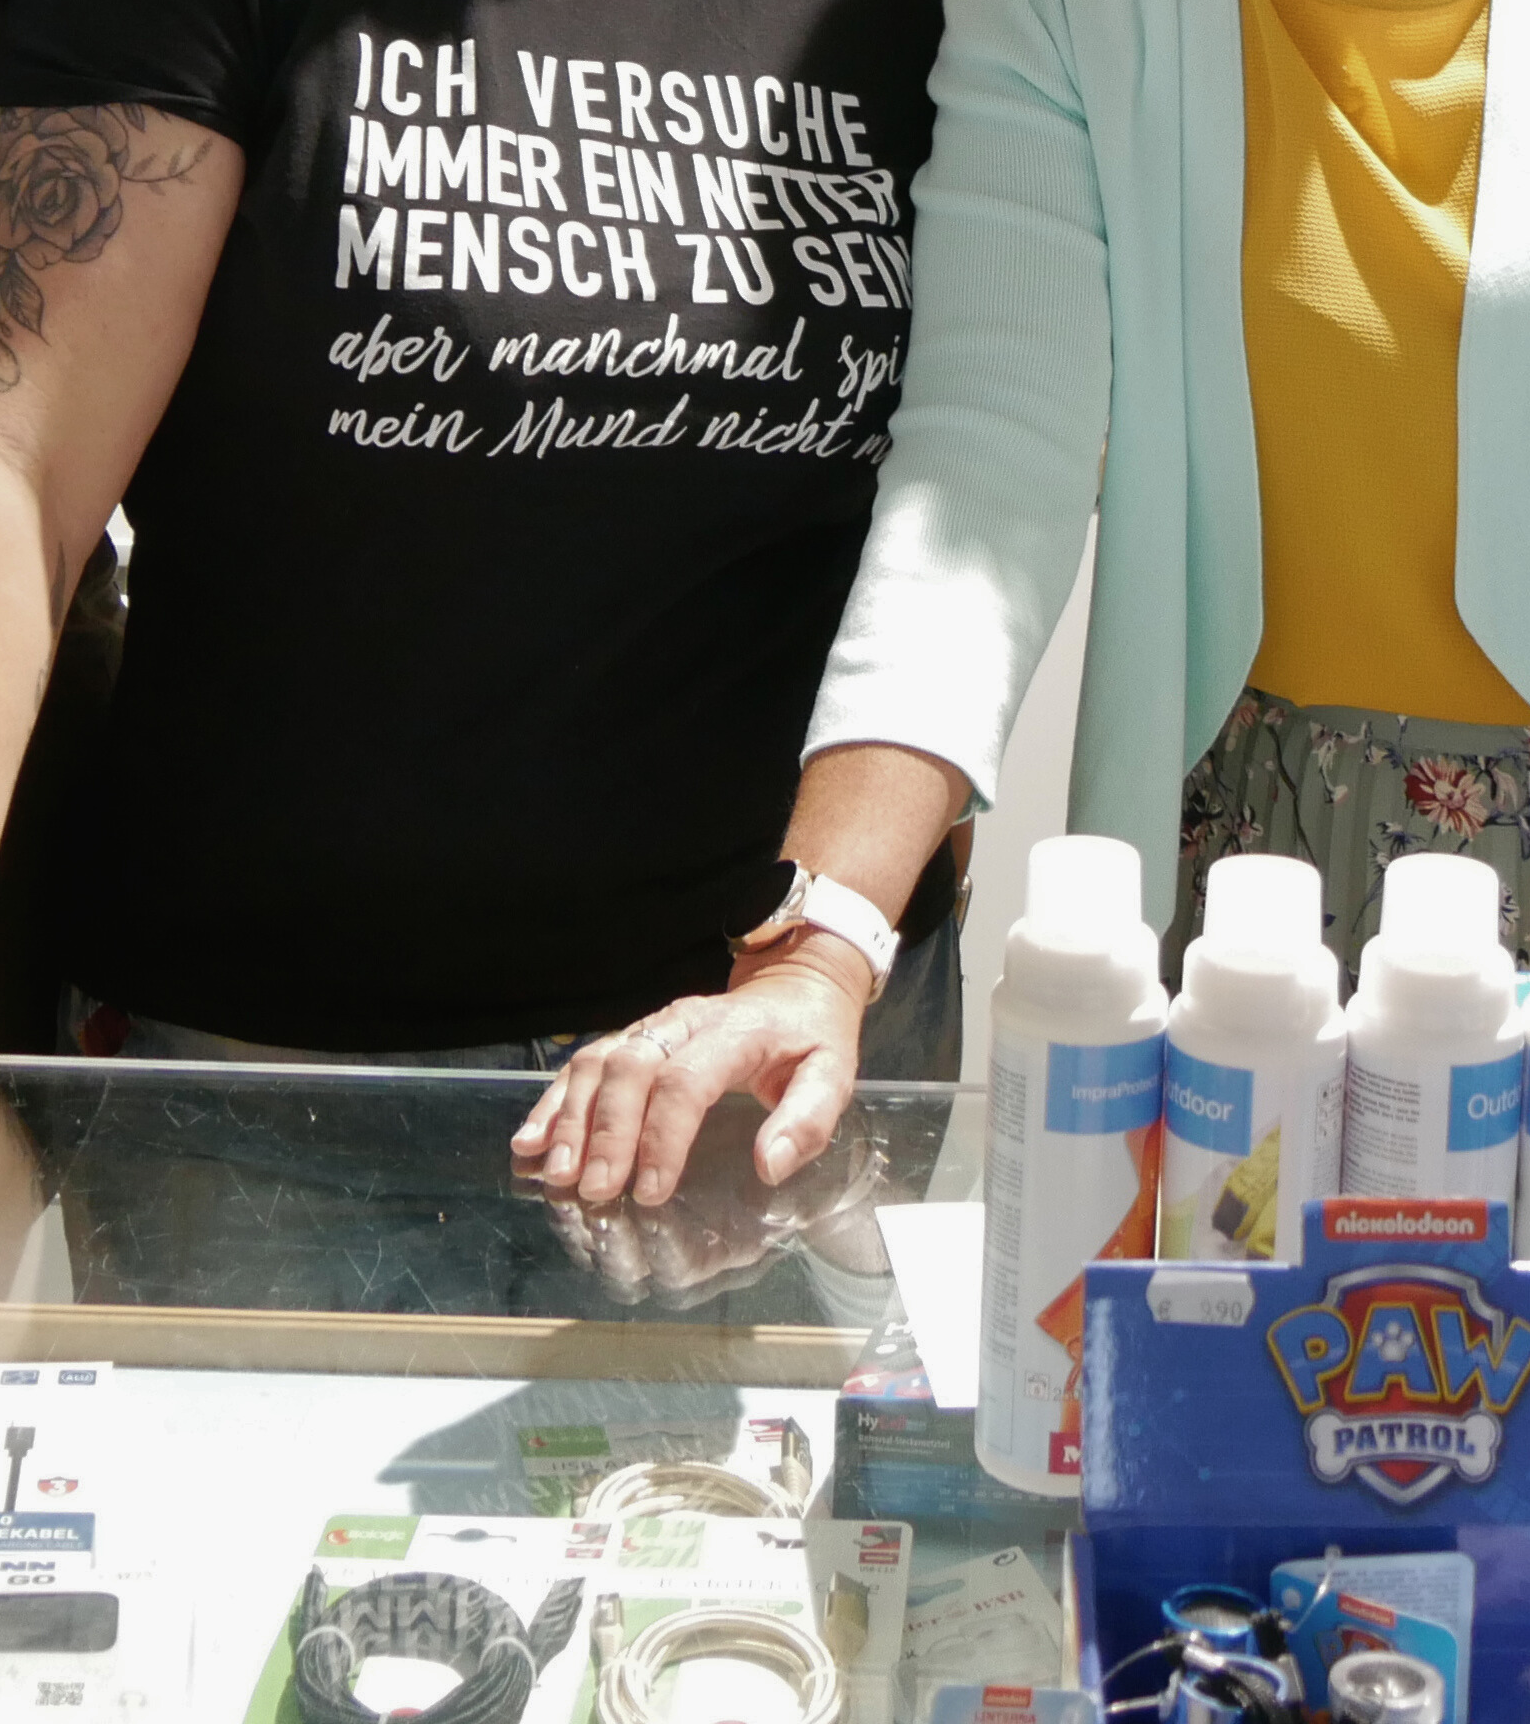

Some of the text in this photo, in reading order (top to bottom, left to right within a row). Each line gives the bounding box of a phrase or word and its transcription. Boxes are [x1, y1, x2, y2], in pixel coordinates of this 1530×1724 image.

[355, 33, 872, 167] ICH VERSUCHE
[344, 115, 900, 231] IMMER EIN NETTER
[334, 204, 913, 309] MENSCH ZU SEIN
[328, 312, 805, 382] aber manchmal
[328, 393, 853, 458] mein Mund nicht
[1336, 1213, 1475, 1236] nickelodeon
[1334, 1421, 1475, 1456] PATROL
[7, 1573, 57, 1586] GO
